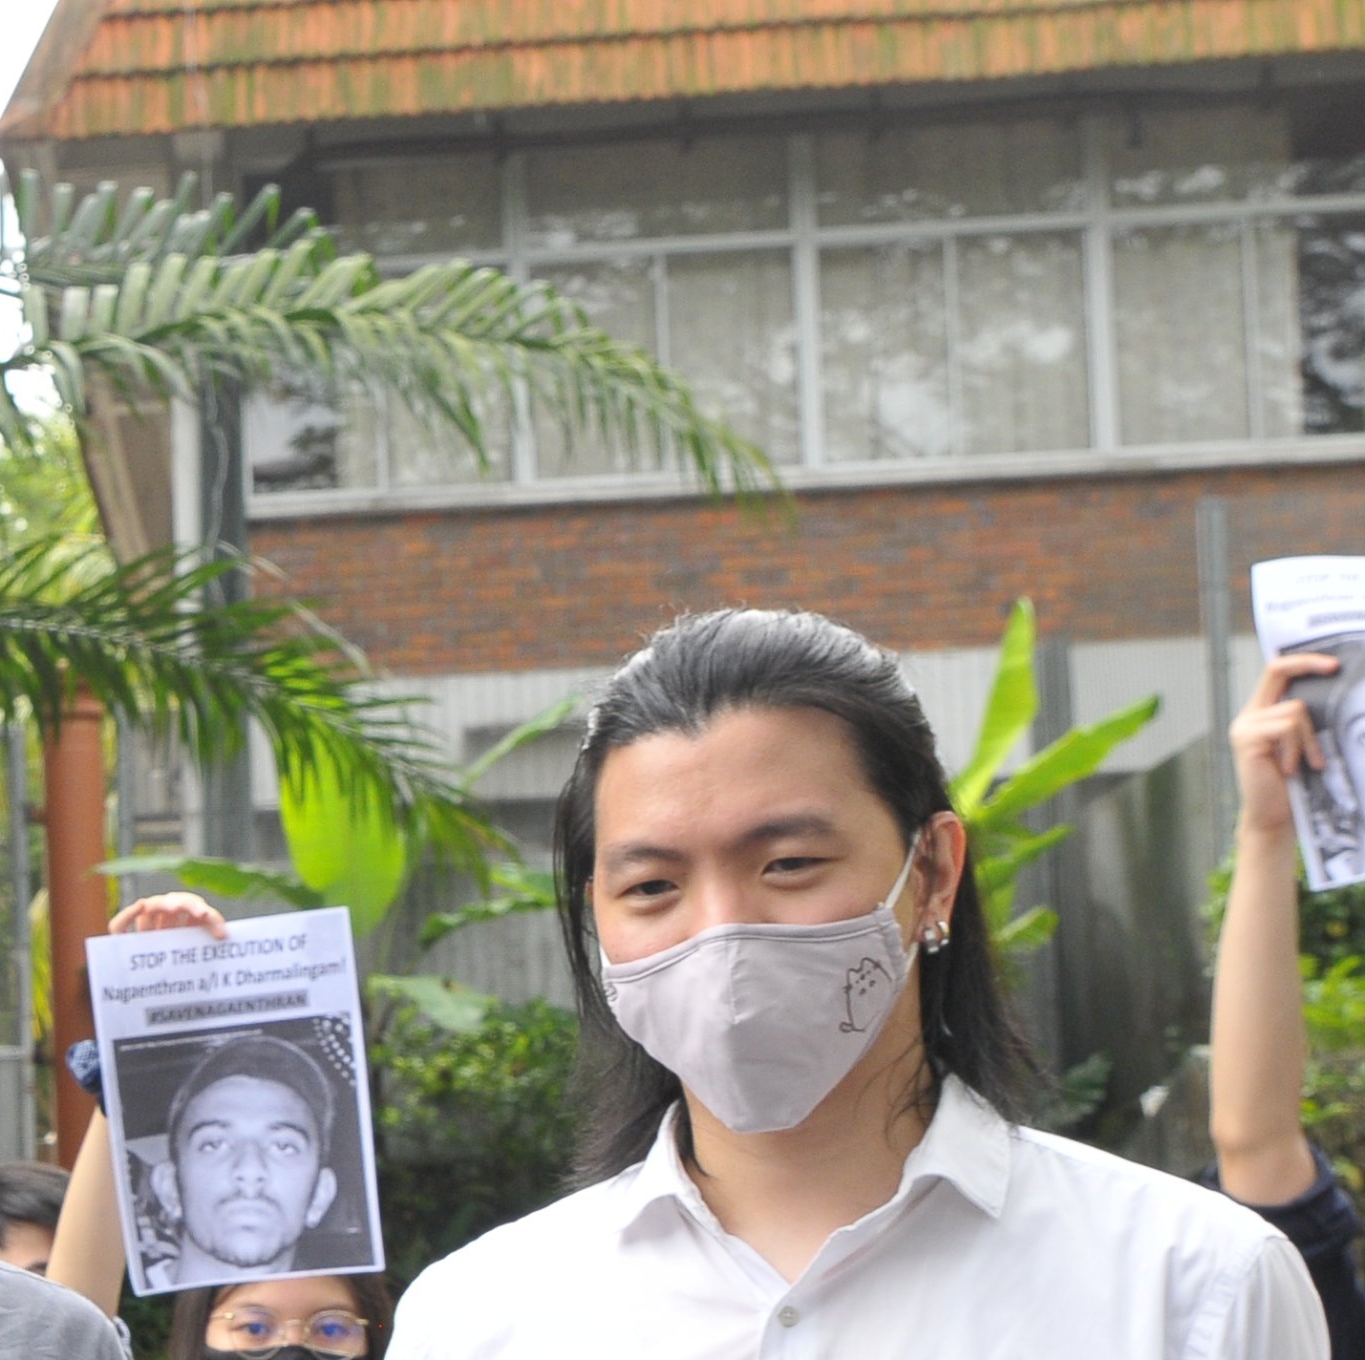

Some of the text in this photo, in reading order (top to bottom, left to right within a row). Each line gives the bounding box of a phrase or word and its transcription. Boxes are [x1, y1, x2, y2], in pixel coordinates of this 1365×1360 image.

[130, 934, 306, 971] STOP THE EXECUTION OF
[101, 976, 194, 1003] Nagaenthran
[223, 972, 231, 987] K
[235, 957, 347, 985] Dharmalingam!
[150, 991, 307, 1024] #SAVENAGAENTHRAN
